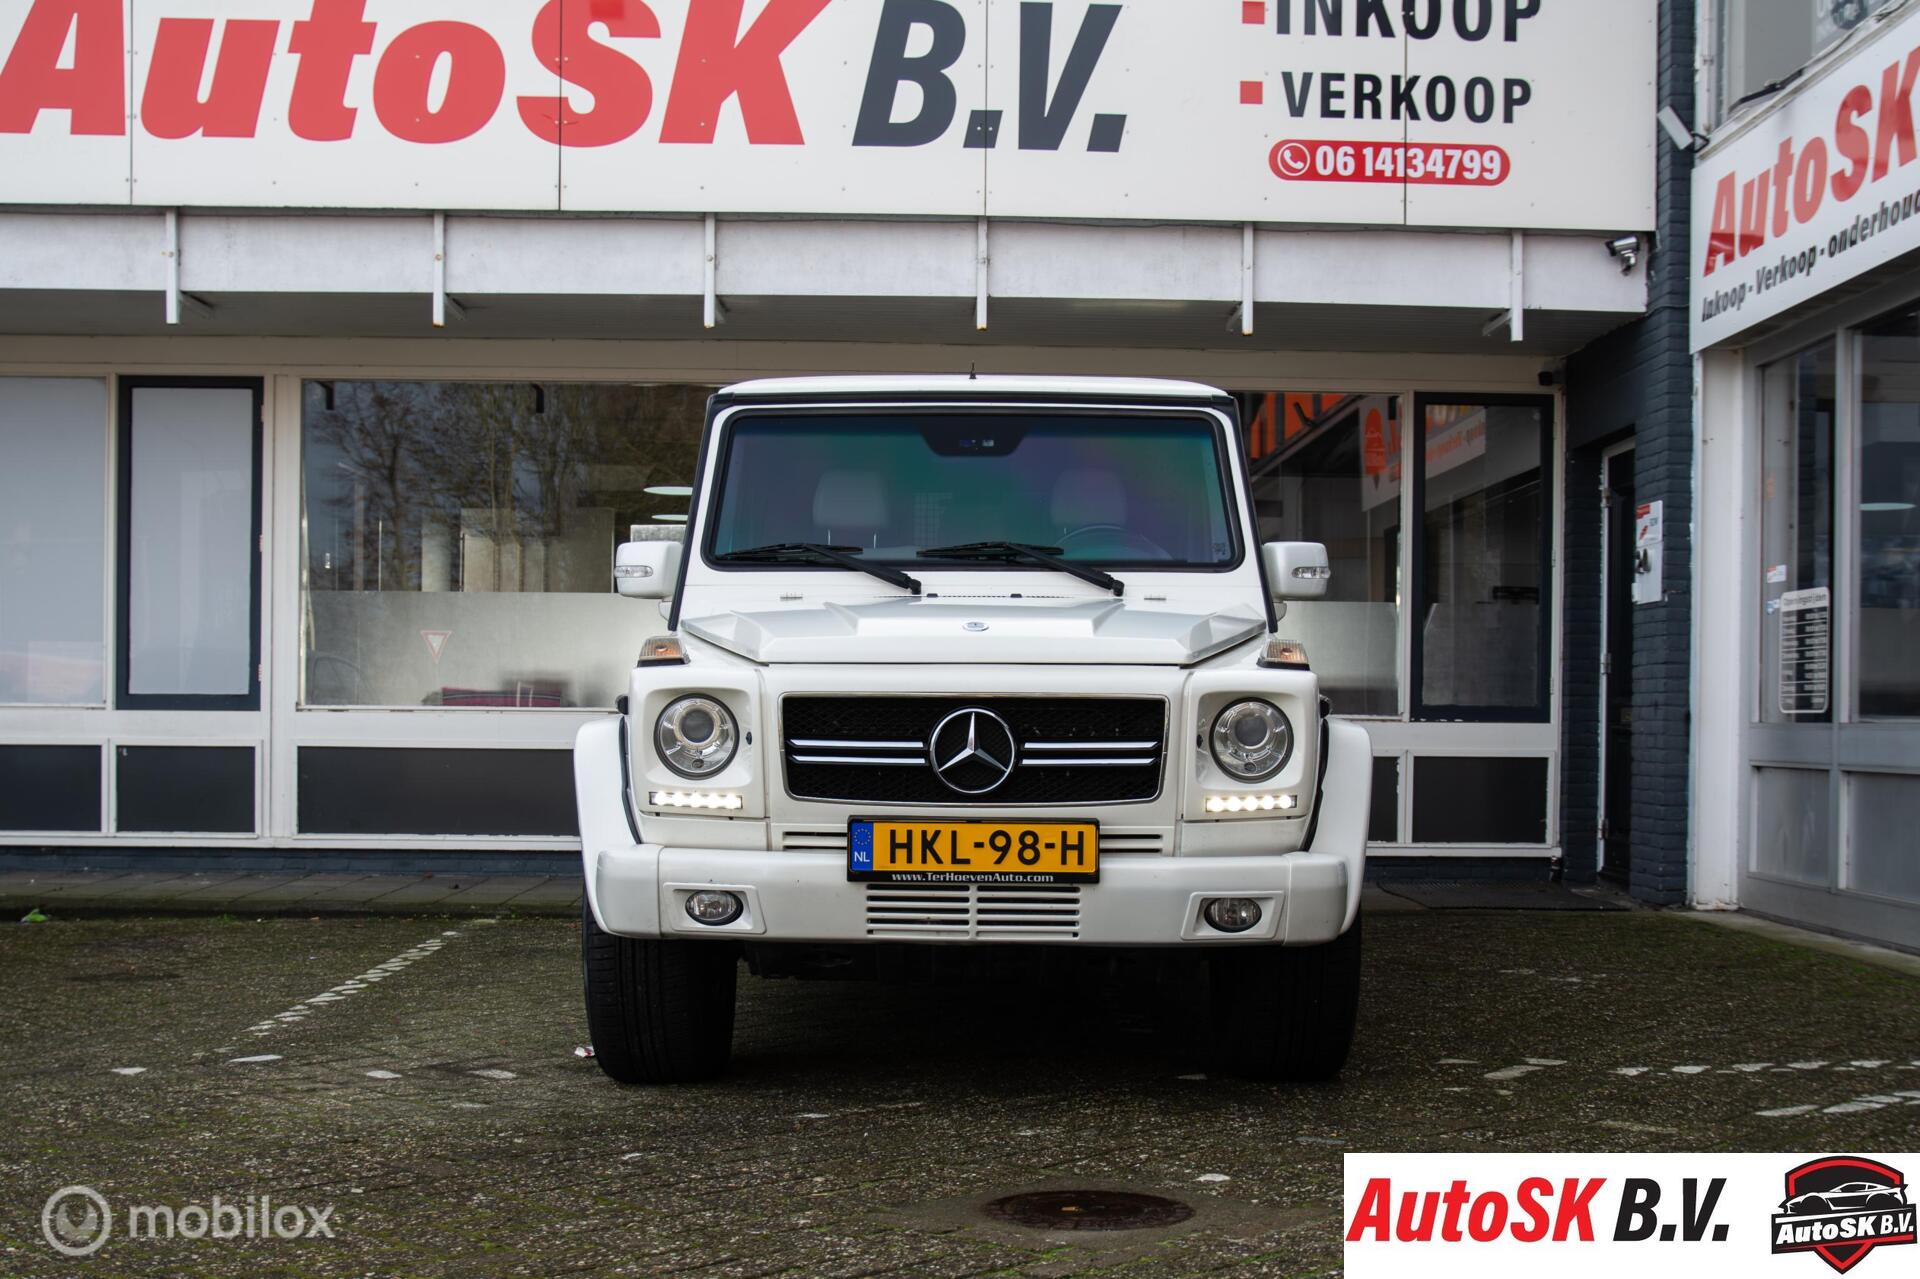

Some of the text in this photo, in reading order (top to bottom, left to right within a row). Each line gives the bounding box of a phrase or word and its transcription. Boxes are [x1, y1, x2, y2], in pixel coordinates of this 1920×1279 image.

[1276, 0, 1543, 42] INKOOP
[0, 0, 1127, 153] AutoSK B.V.
[1281, 71, 1532, 124] VERKOOP
[1315, 145, 1501, 181] 06 14134799
[1703, 45, 1920, 278] AutoSK
[1702, 282, 1746, 322] Inkoop
[1756, 245, 1817, 295] Verkoop
[854, 851, 870, 863] NL
[889, 829, 1084, 866] HKL-98-H
[892, 872, 1054, 883] www.TerHoevenAuto.com
